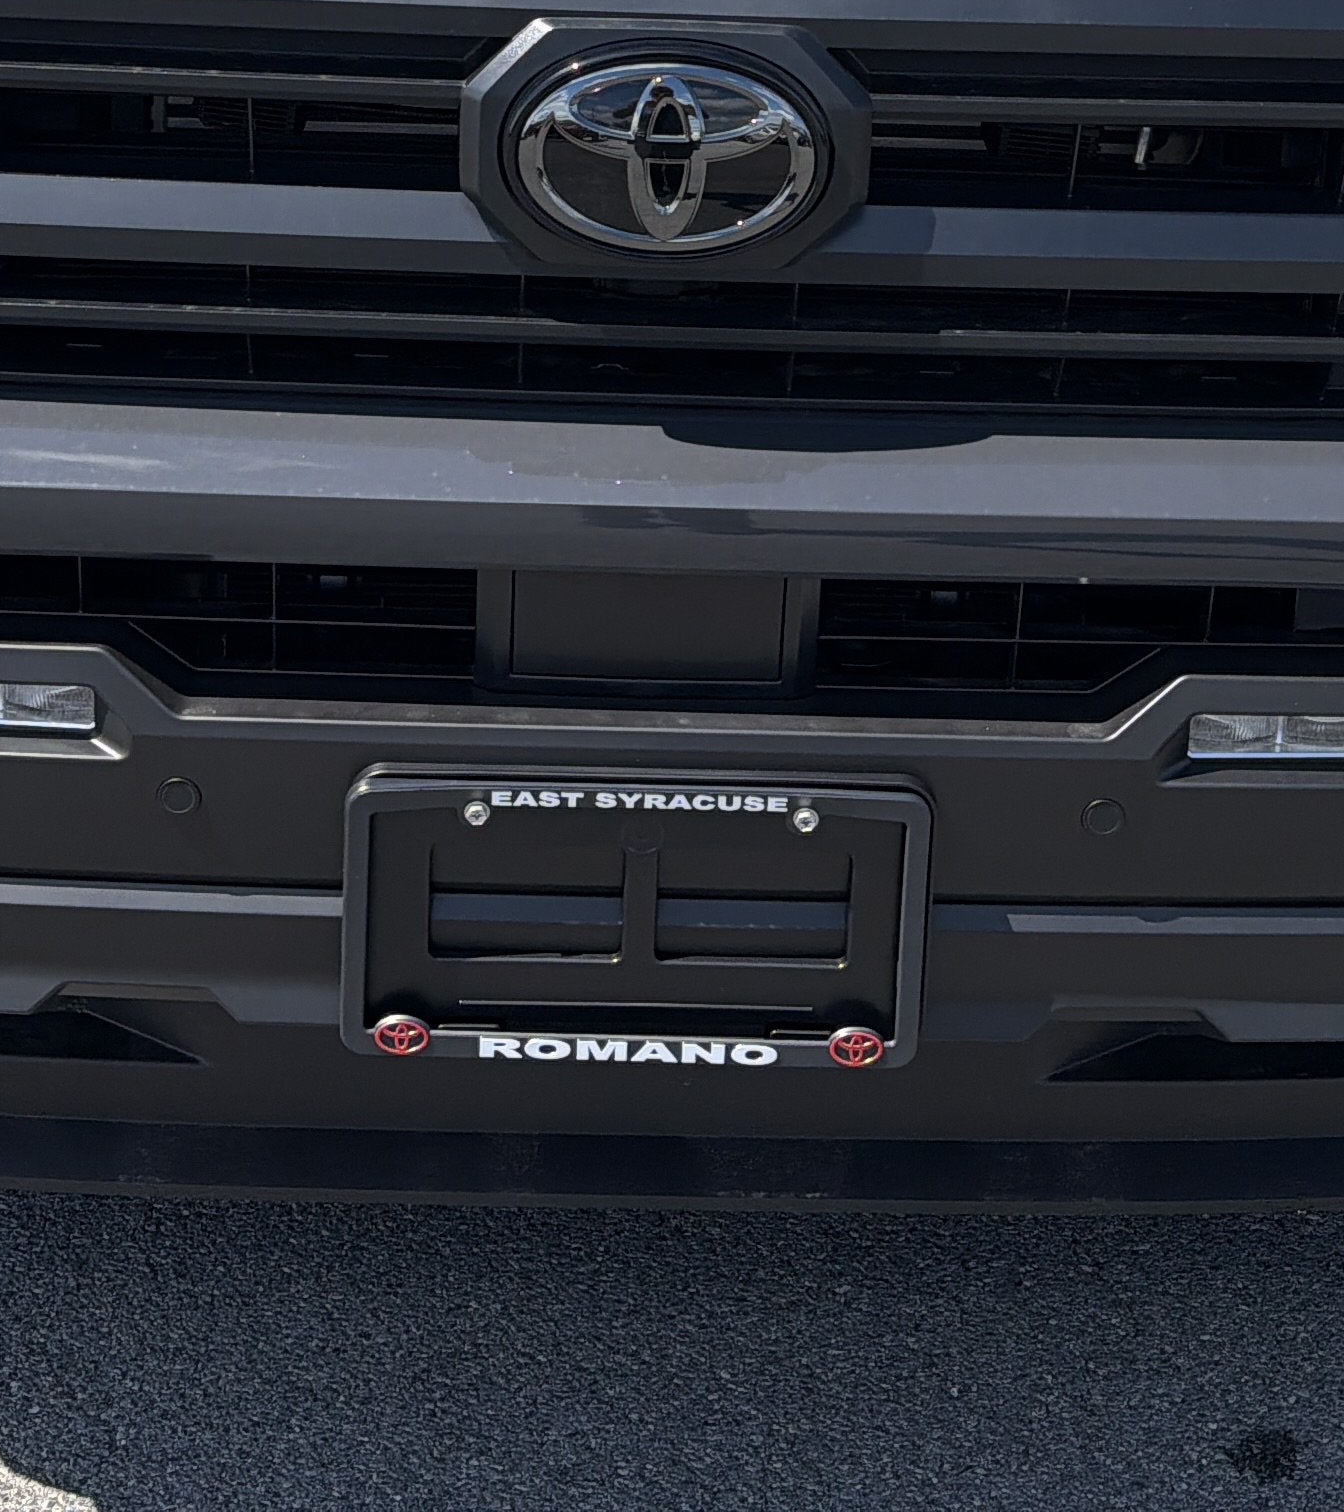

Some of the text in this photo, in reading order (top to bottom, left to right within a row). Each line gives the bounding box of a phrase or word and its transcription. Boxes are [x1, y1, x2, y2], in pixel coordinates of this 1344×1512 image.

[490, 791, 789, 813] EAST SYRACUSE
[479, 1036, 778, 1066] ROMANO
